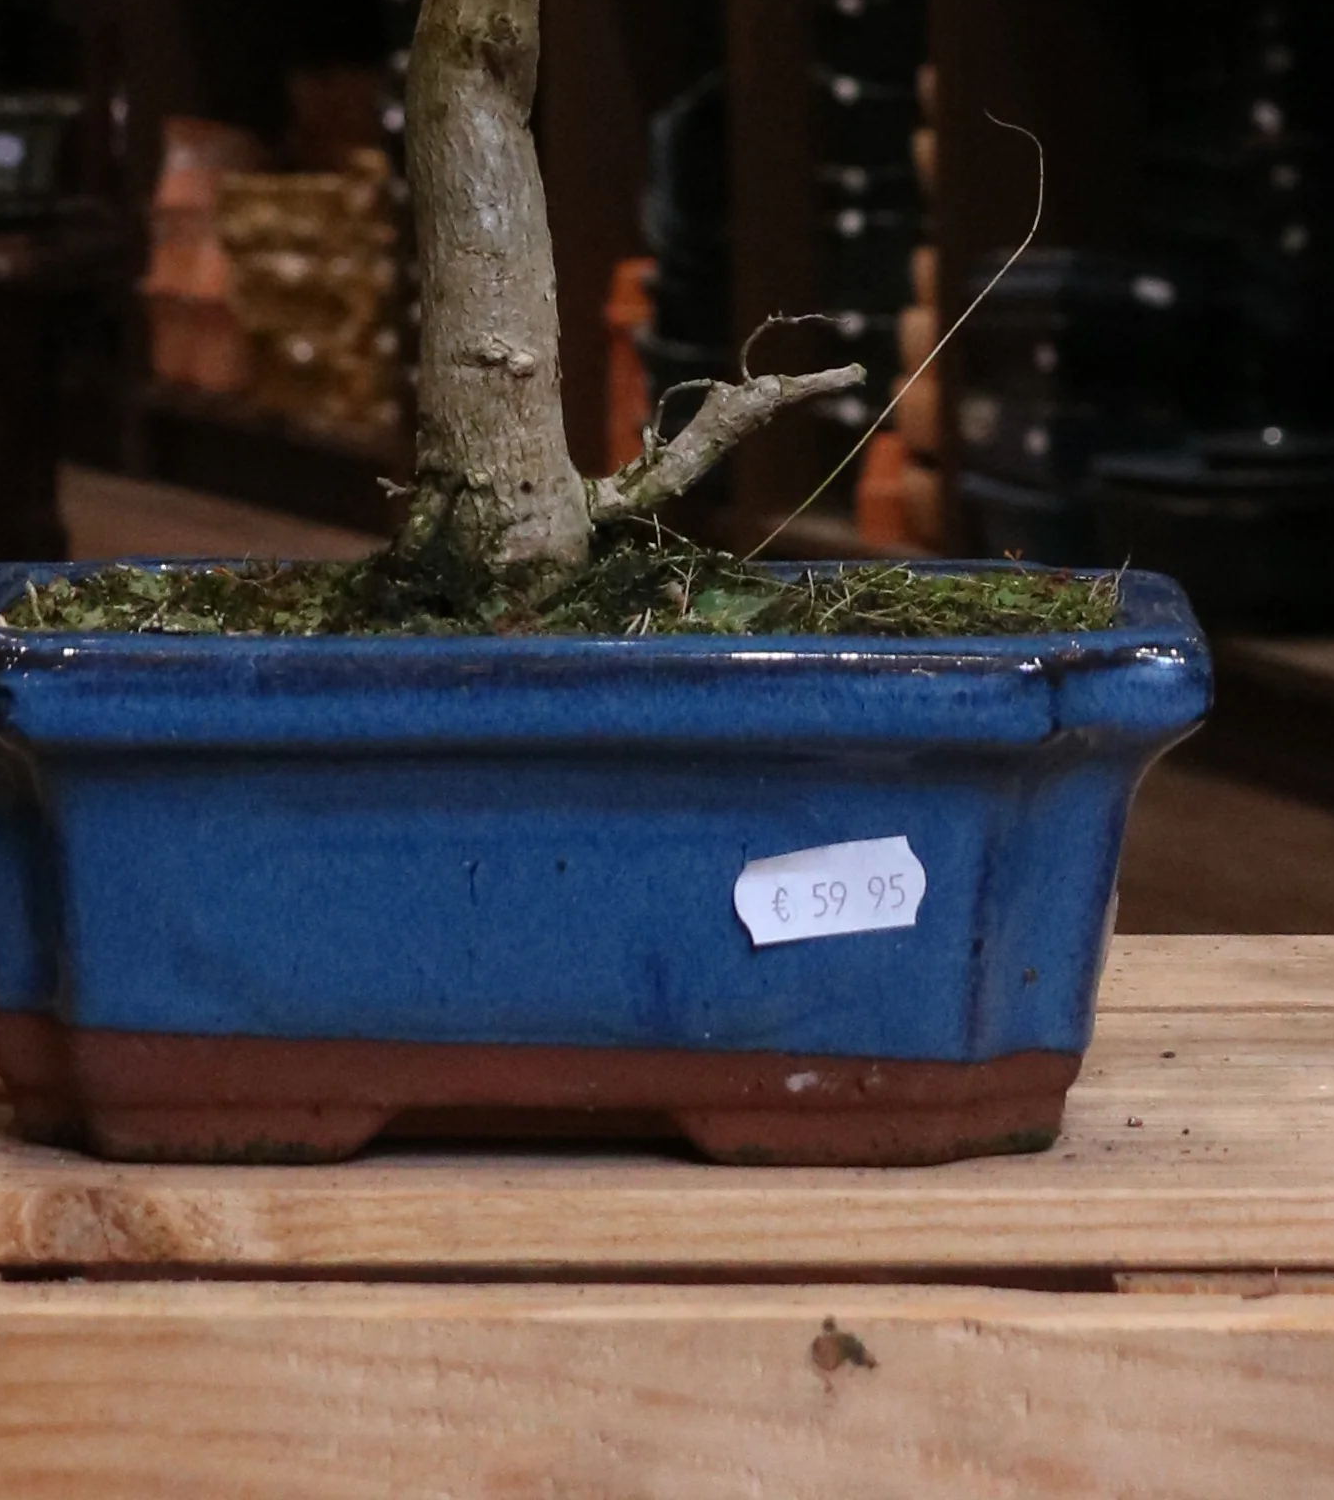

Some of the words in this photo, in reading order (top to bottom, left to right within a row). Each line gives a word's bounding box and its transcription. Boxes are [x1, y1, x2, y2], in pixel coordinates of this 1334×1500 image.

[771, 886, 791, 923] €
[812, 880, 847, 918] 59
[867, 873, 906, 909] 95
